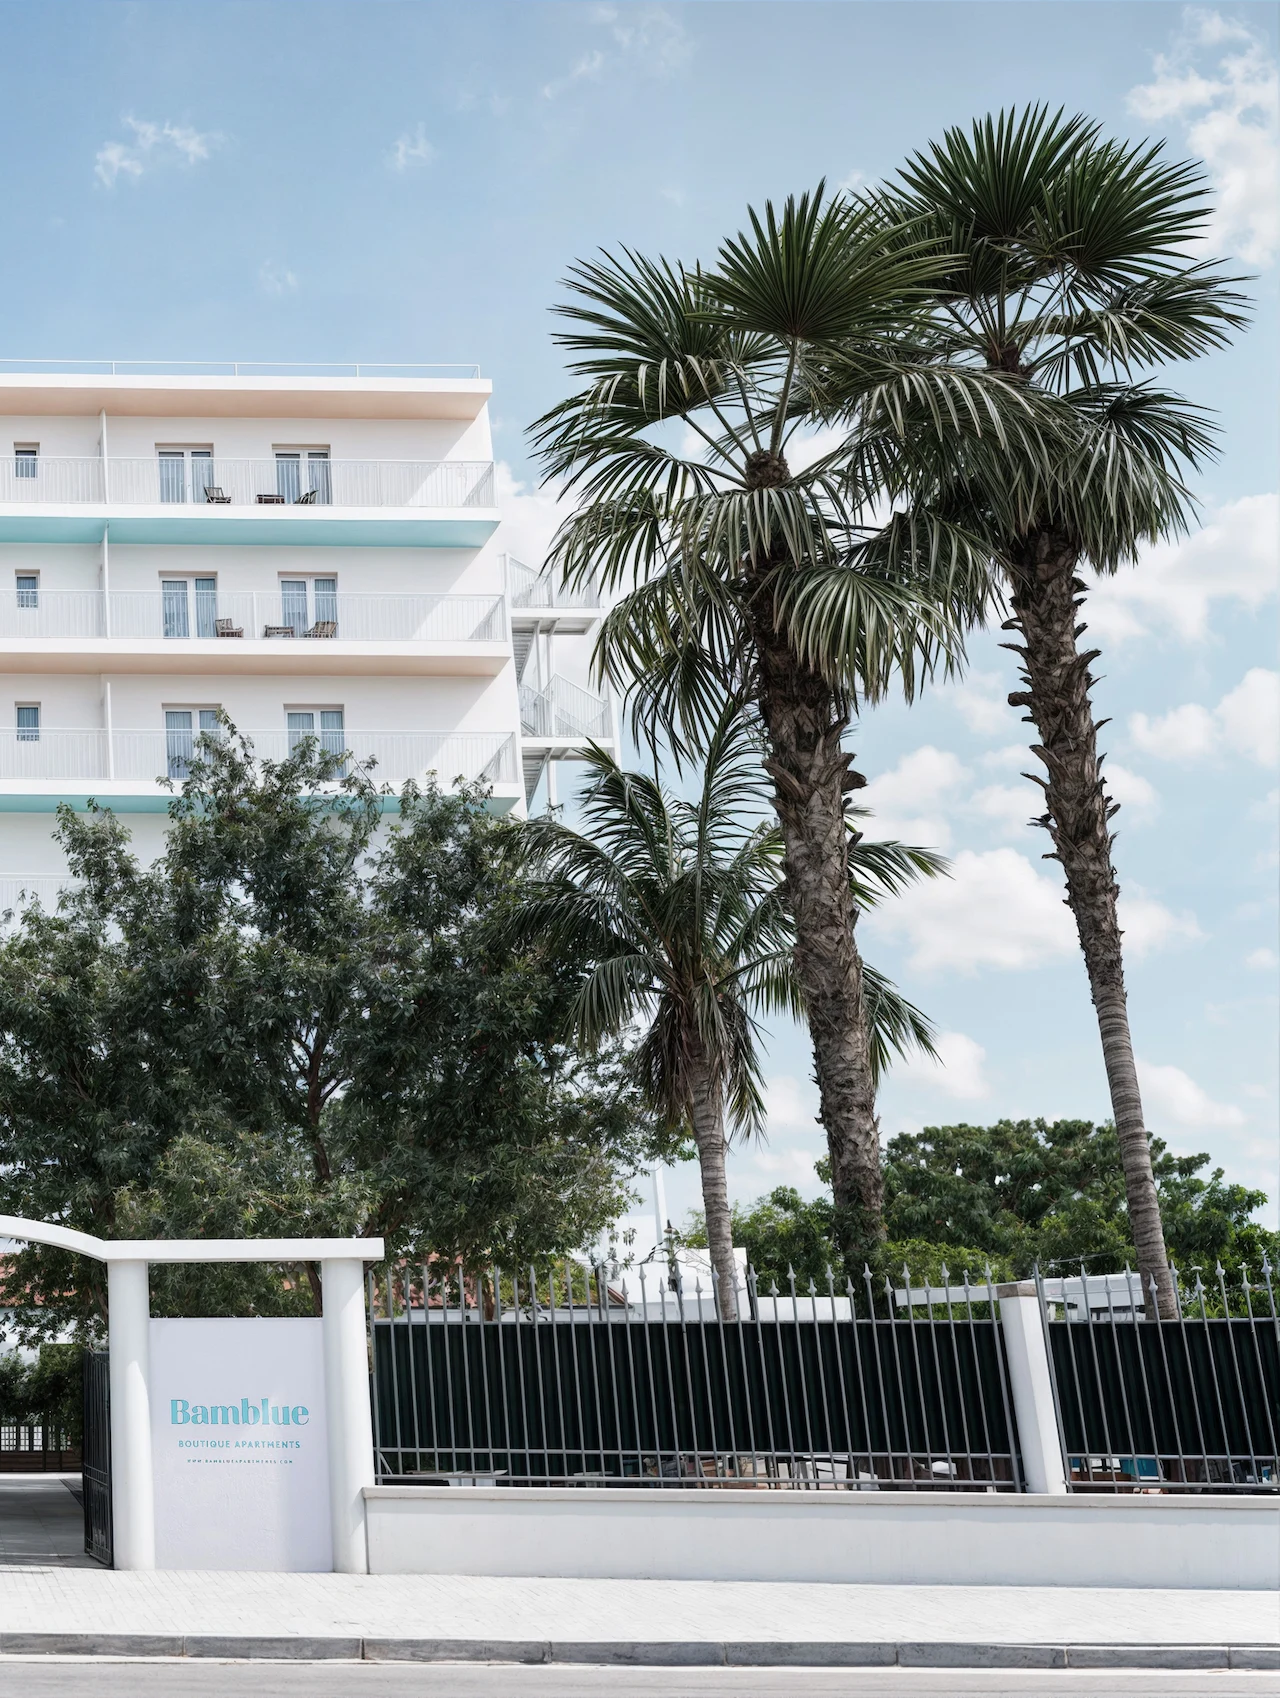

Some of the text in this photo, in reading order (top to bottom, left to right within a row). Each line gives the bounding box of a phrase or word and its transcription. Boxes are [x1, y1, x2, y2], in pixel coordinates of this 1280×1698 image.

[170, 1398, 310, 1426] Bamblue
[178, 1440, 301, 1449] BOUTIQUE APARTMENTS
